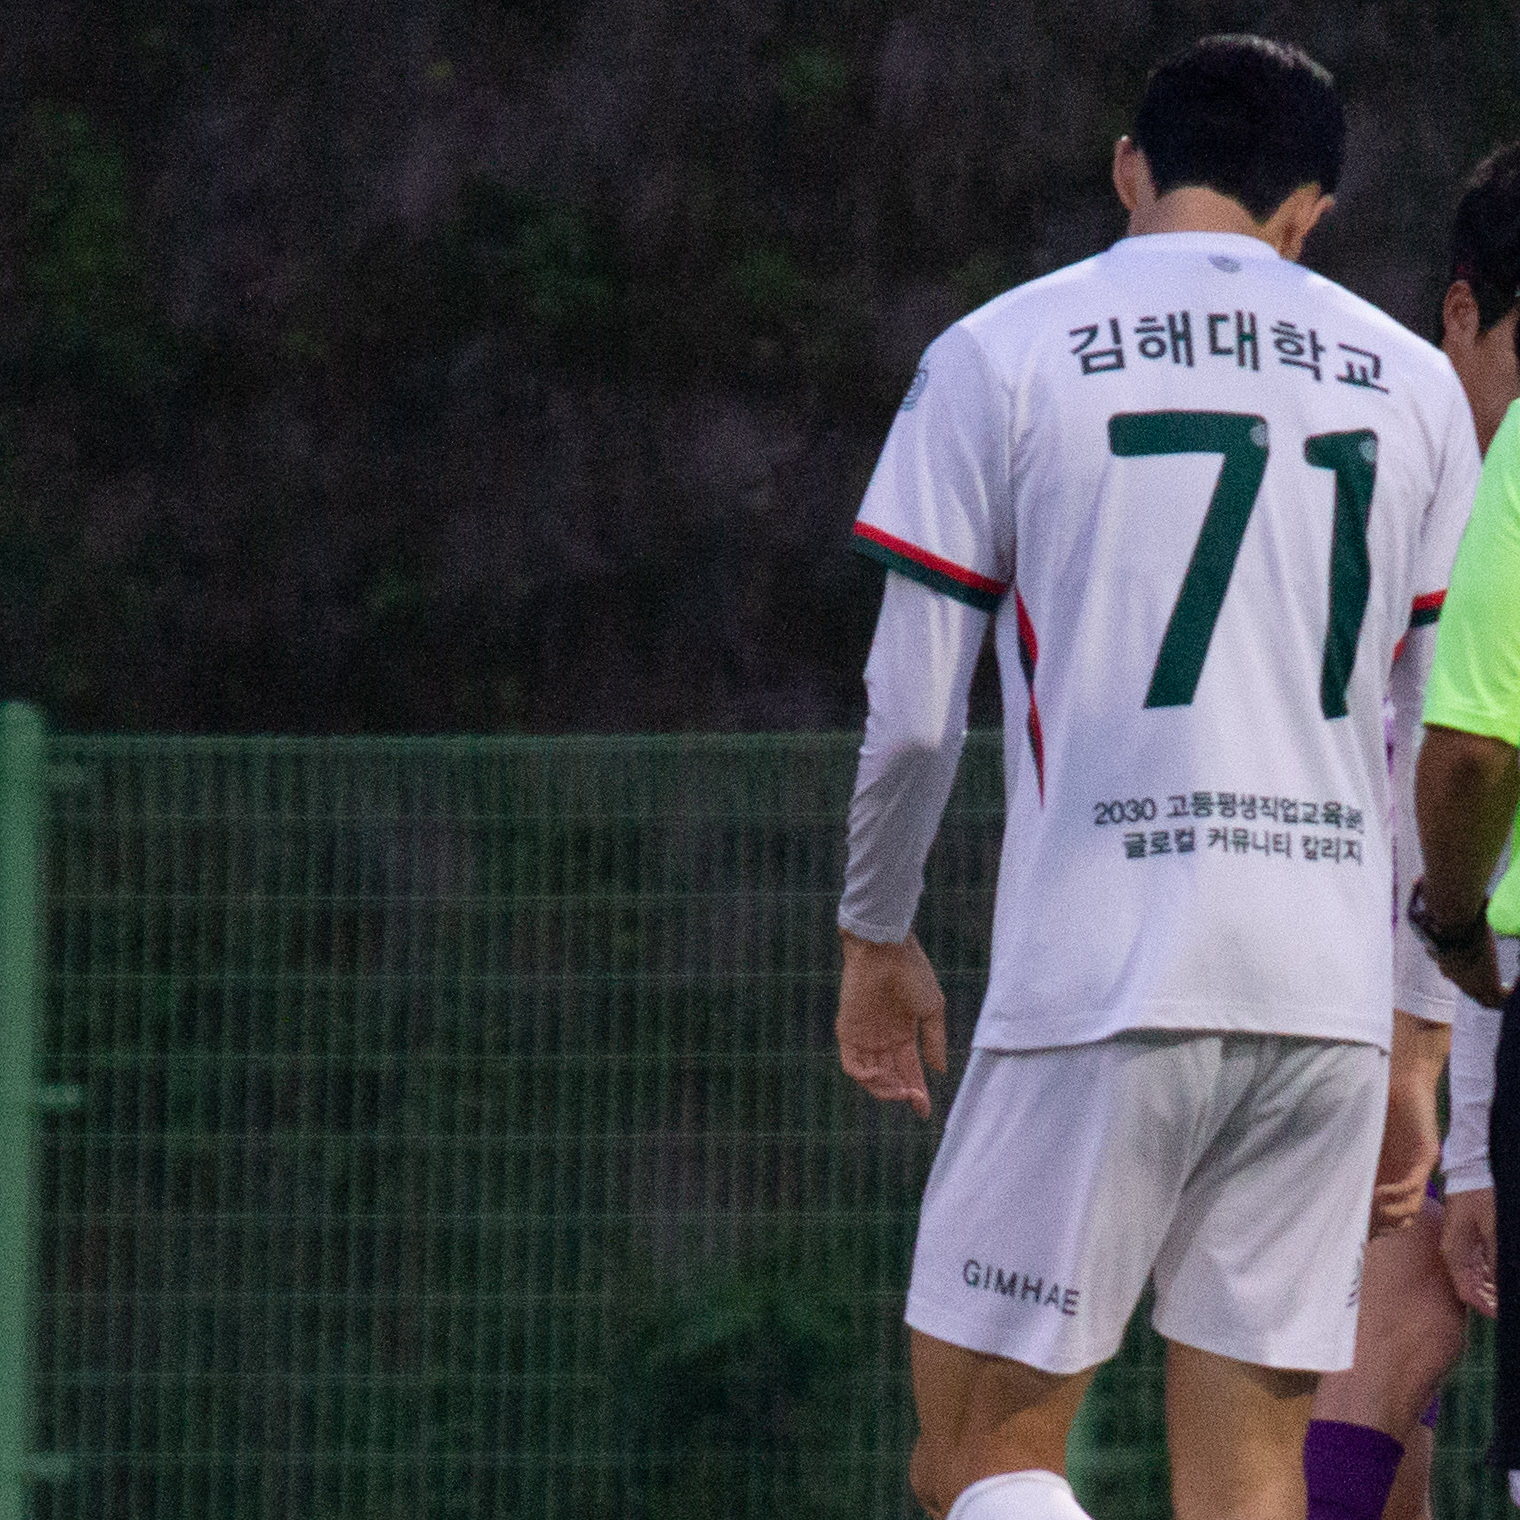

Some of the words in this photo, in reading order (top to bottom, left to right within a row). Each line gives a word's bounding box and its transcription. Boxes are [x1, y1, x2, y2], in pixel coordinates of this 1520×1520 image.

[1068, 309, 1390, 394] 김해대학교
[1107, 408, 1379, 720] 71
[1093, 797, 1158, 826] 2030
[1124, 826, 1196, 860] 글로컬
[1206, 826, 1292, 859] 커뮤니티
[1301, 833, 1363, 865] 칼리지
[962, 1257, 1080, 1317] GIMHAE
